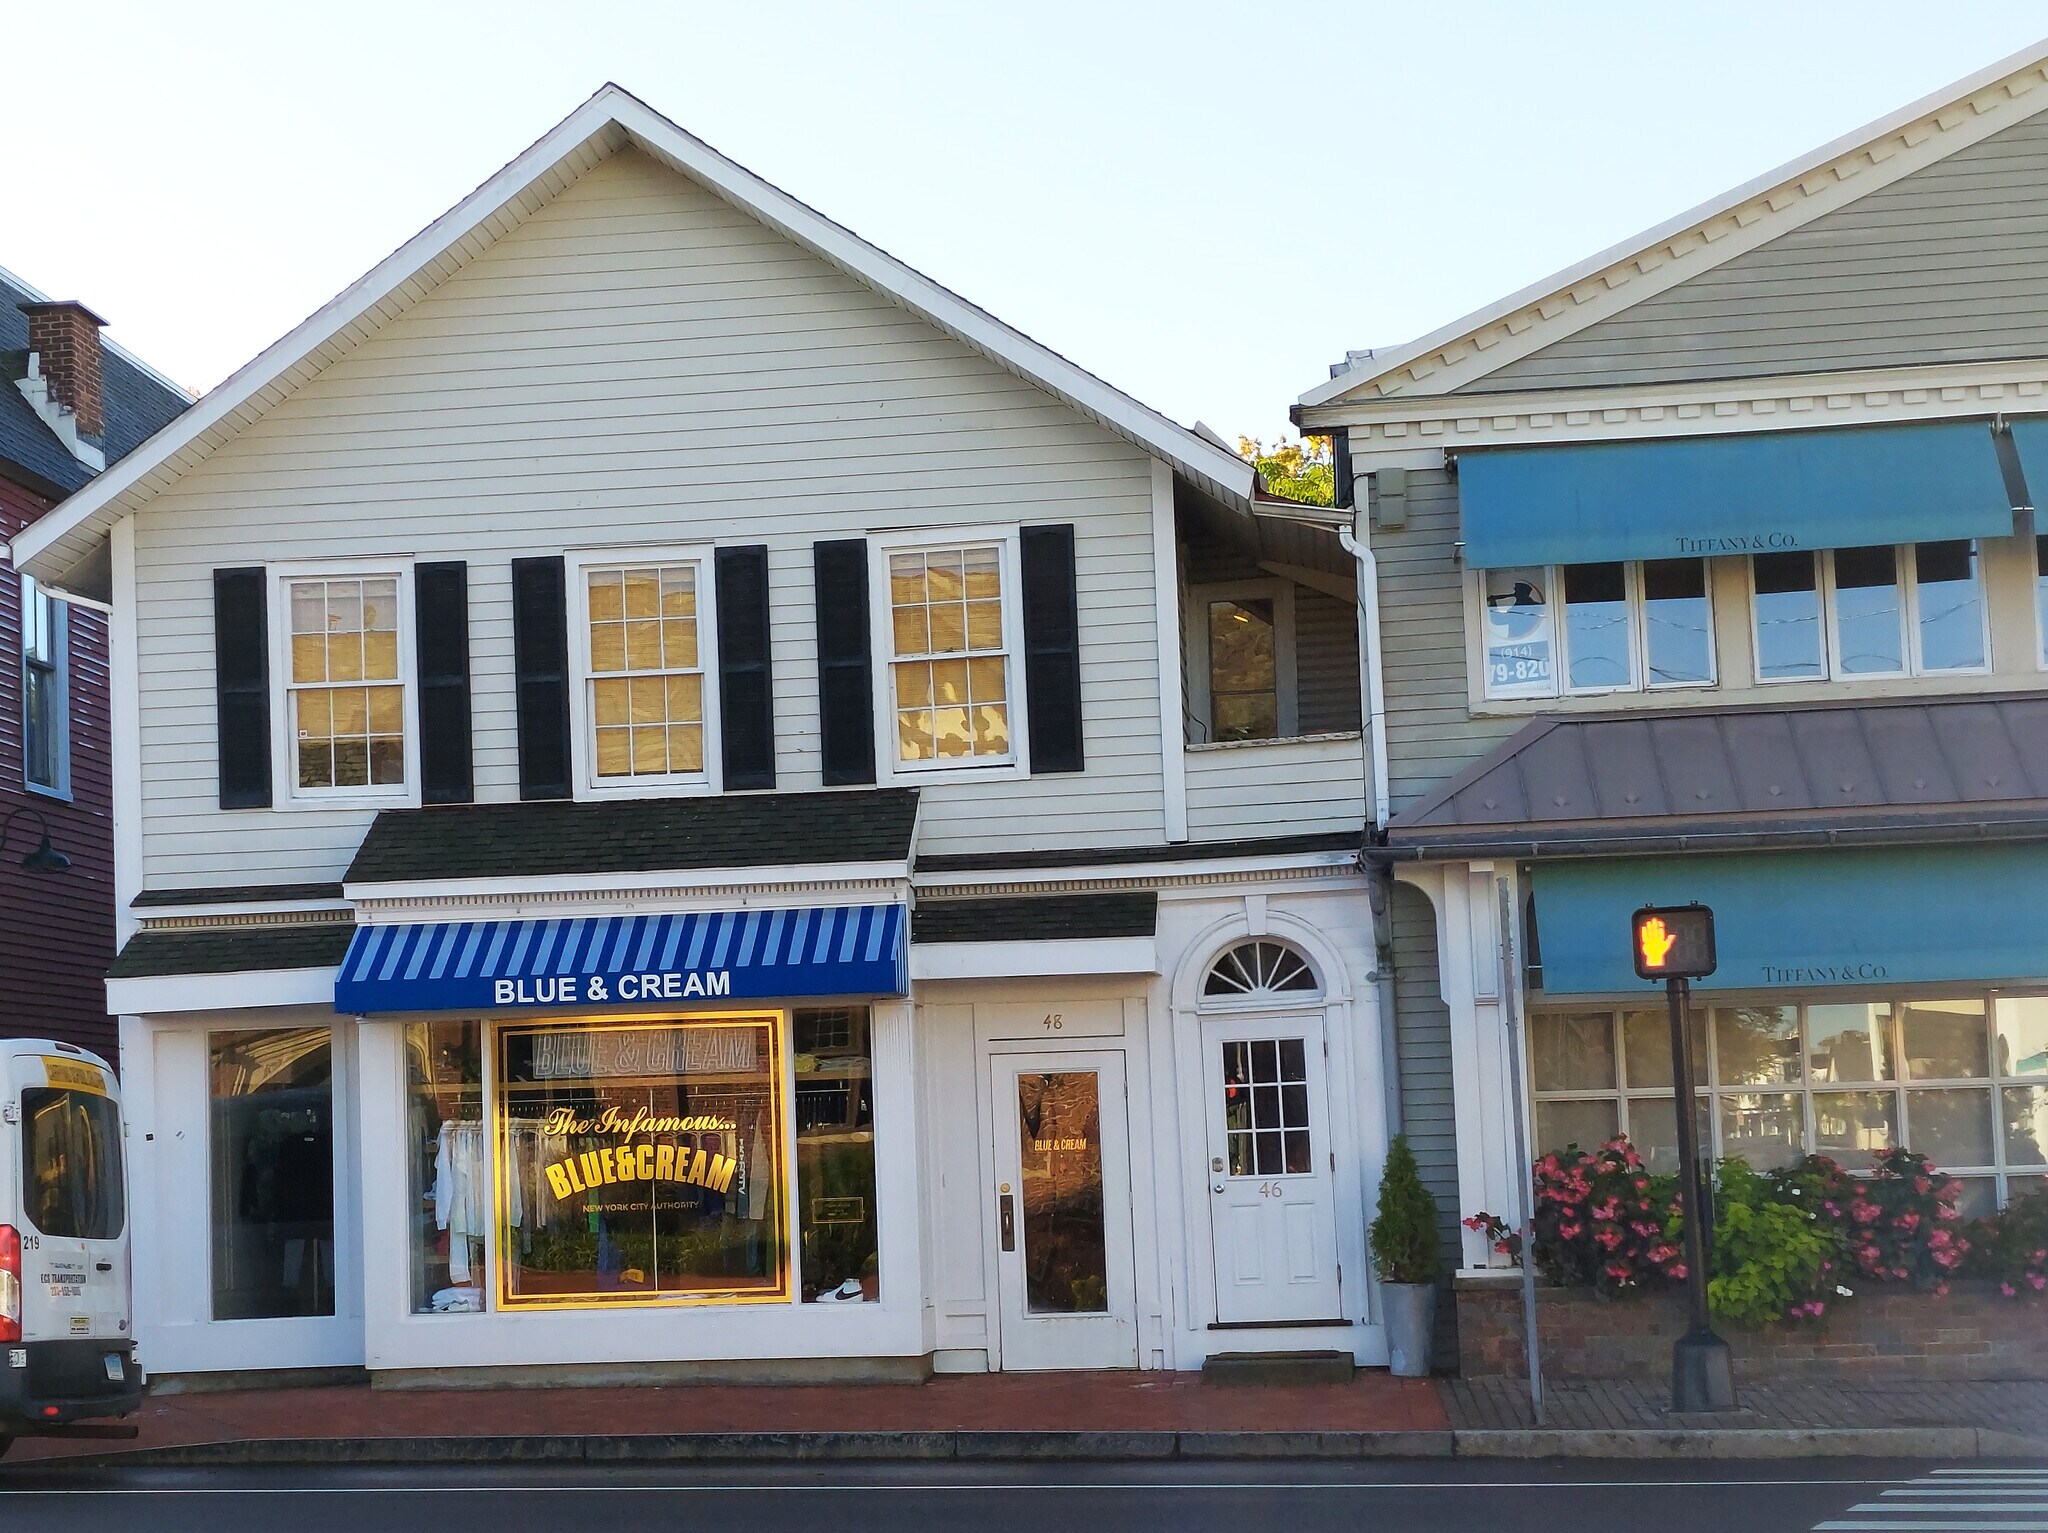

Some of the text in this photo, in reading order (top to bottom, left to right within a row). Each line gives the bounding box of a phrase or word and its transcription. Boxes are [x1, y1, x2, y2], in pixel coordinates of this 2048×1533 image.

[1676, 537, 1750, 553] TIFFANY
[1752, 534, 1765, 549] &
[1501, 645, 1532, 659] (914)
[1762, 966, 1838, 983] TIFFANY
[1842, 964, 1855, 980] &
[495, 970, 730, 1004] BLUE & CREAM
[1043, 1013, 1063, 1031] 48
[535, 1027, 752, 1076] BLUE & CREAM
[543, 1105, 737, 1144] The Infamous...
[1034, 1137, 1087, 1151] BLUE & CREAM
[545, 1144, 737, 1200] BLUE&CREAM
[1259, 1181, 1283, 1198] 46
[582, 1200, 700, 1213] NEW YORK CITY AUTHORITY
[23, 1235, 40, 1250] 219
